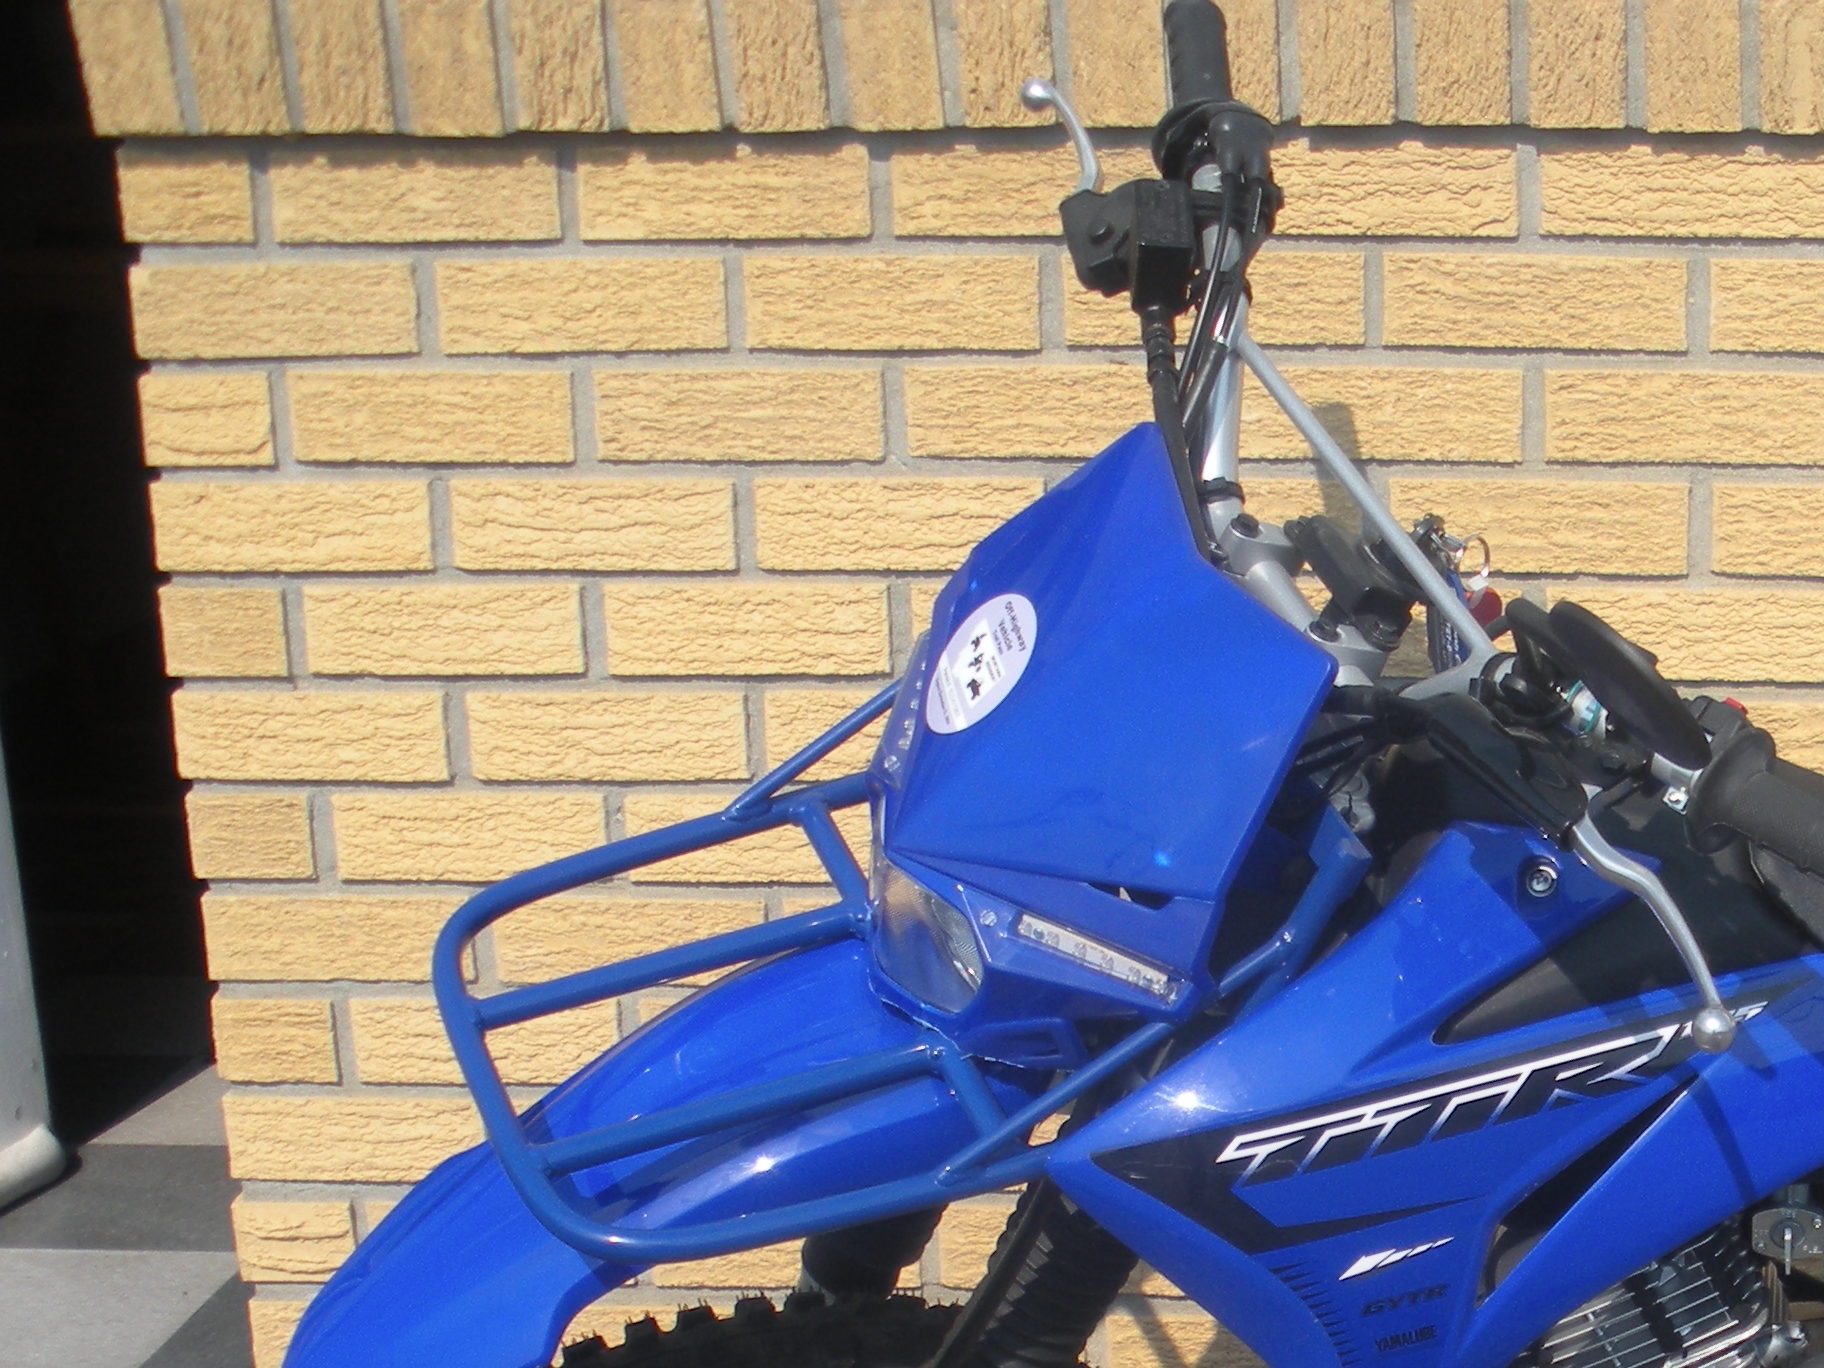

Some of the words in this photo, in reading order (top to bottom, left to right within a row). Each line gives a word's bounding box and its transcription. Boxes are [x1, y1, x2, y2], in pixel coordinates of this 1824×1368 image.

[998, 619, 1013, 651] Vehicle
[1004, 601, 1027, 652] Off-Highway
[1375, 1324, 1436, 1352] YAMALUBE
